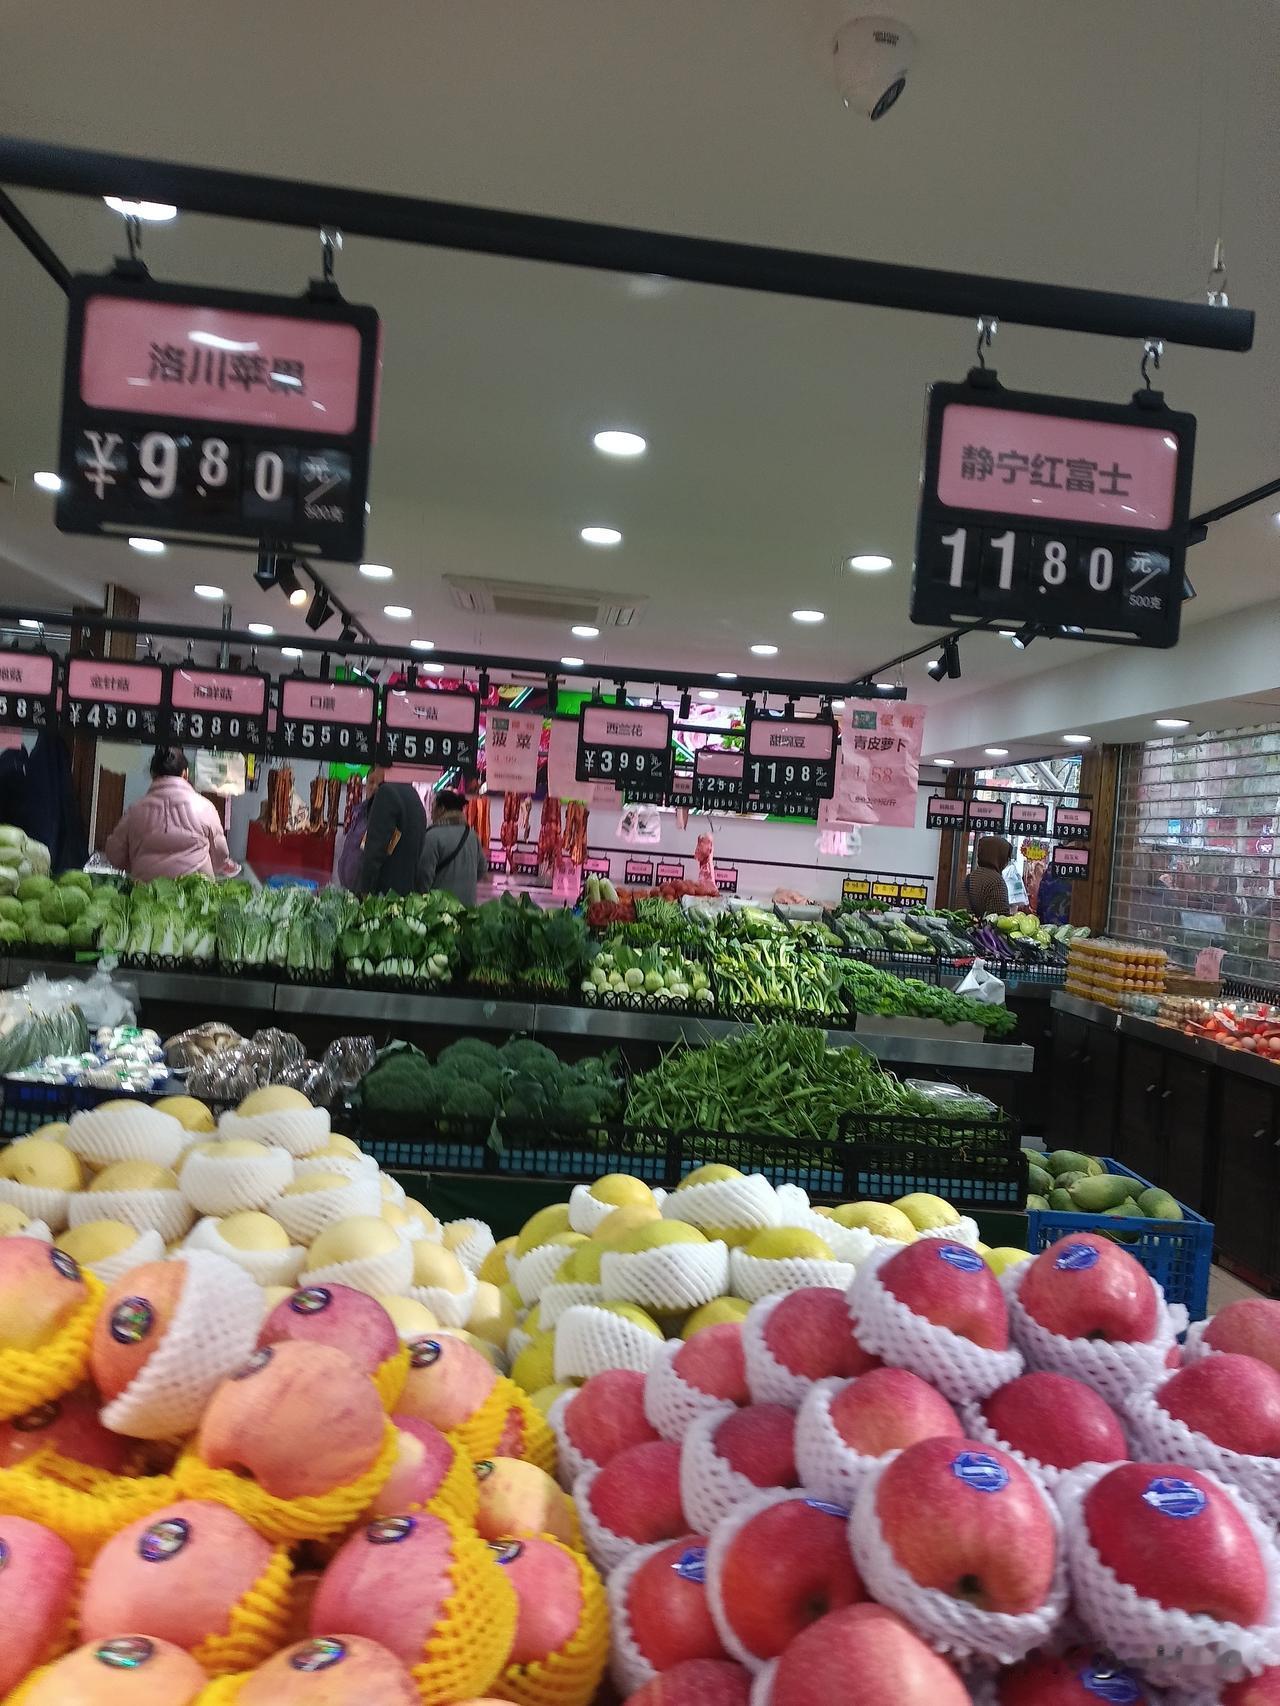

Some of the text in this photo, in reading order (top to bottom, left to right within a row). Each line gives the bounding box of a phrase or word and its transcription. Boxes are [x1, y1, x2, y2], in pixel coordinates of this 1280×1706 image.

[148, 341, 305, 396] 洛川苹果
[961, 445, 1132, 497] 静宁红富士
[606, 721, 643, 737] 西兰花
[854, 736, 907, 752] 青皮萝卜
